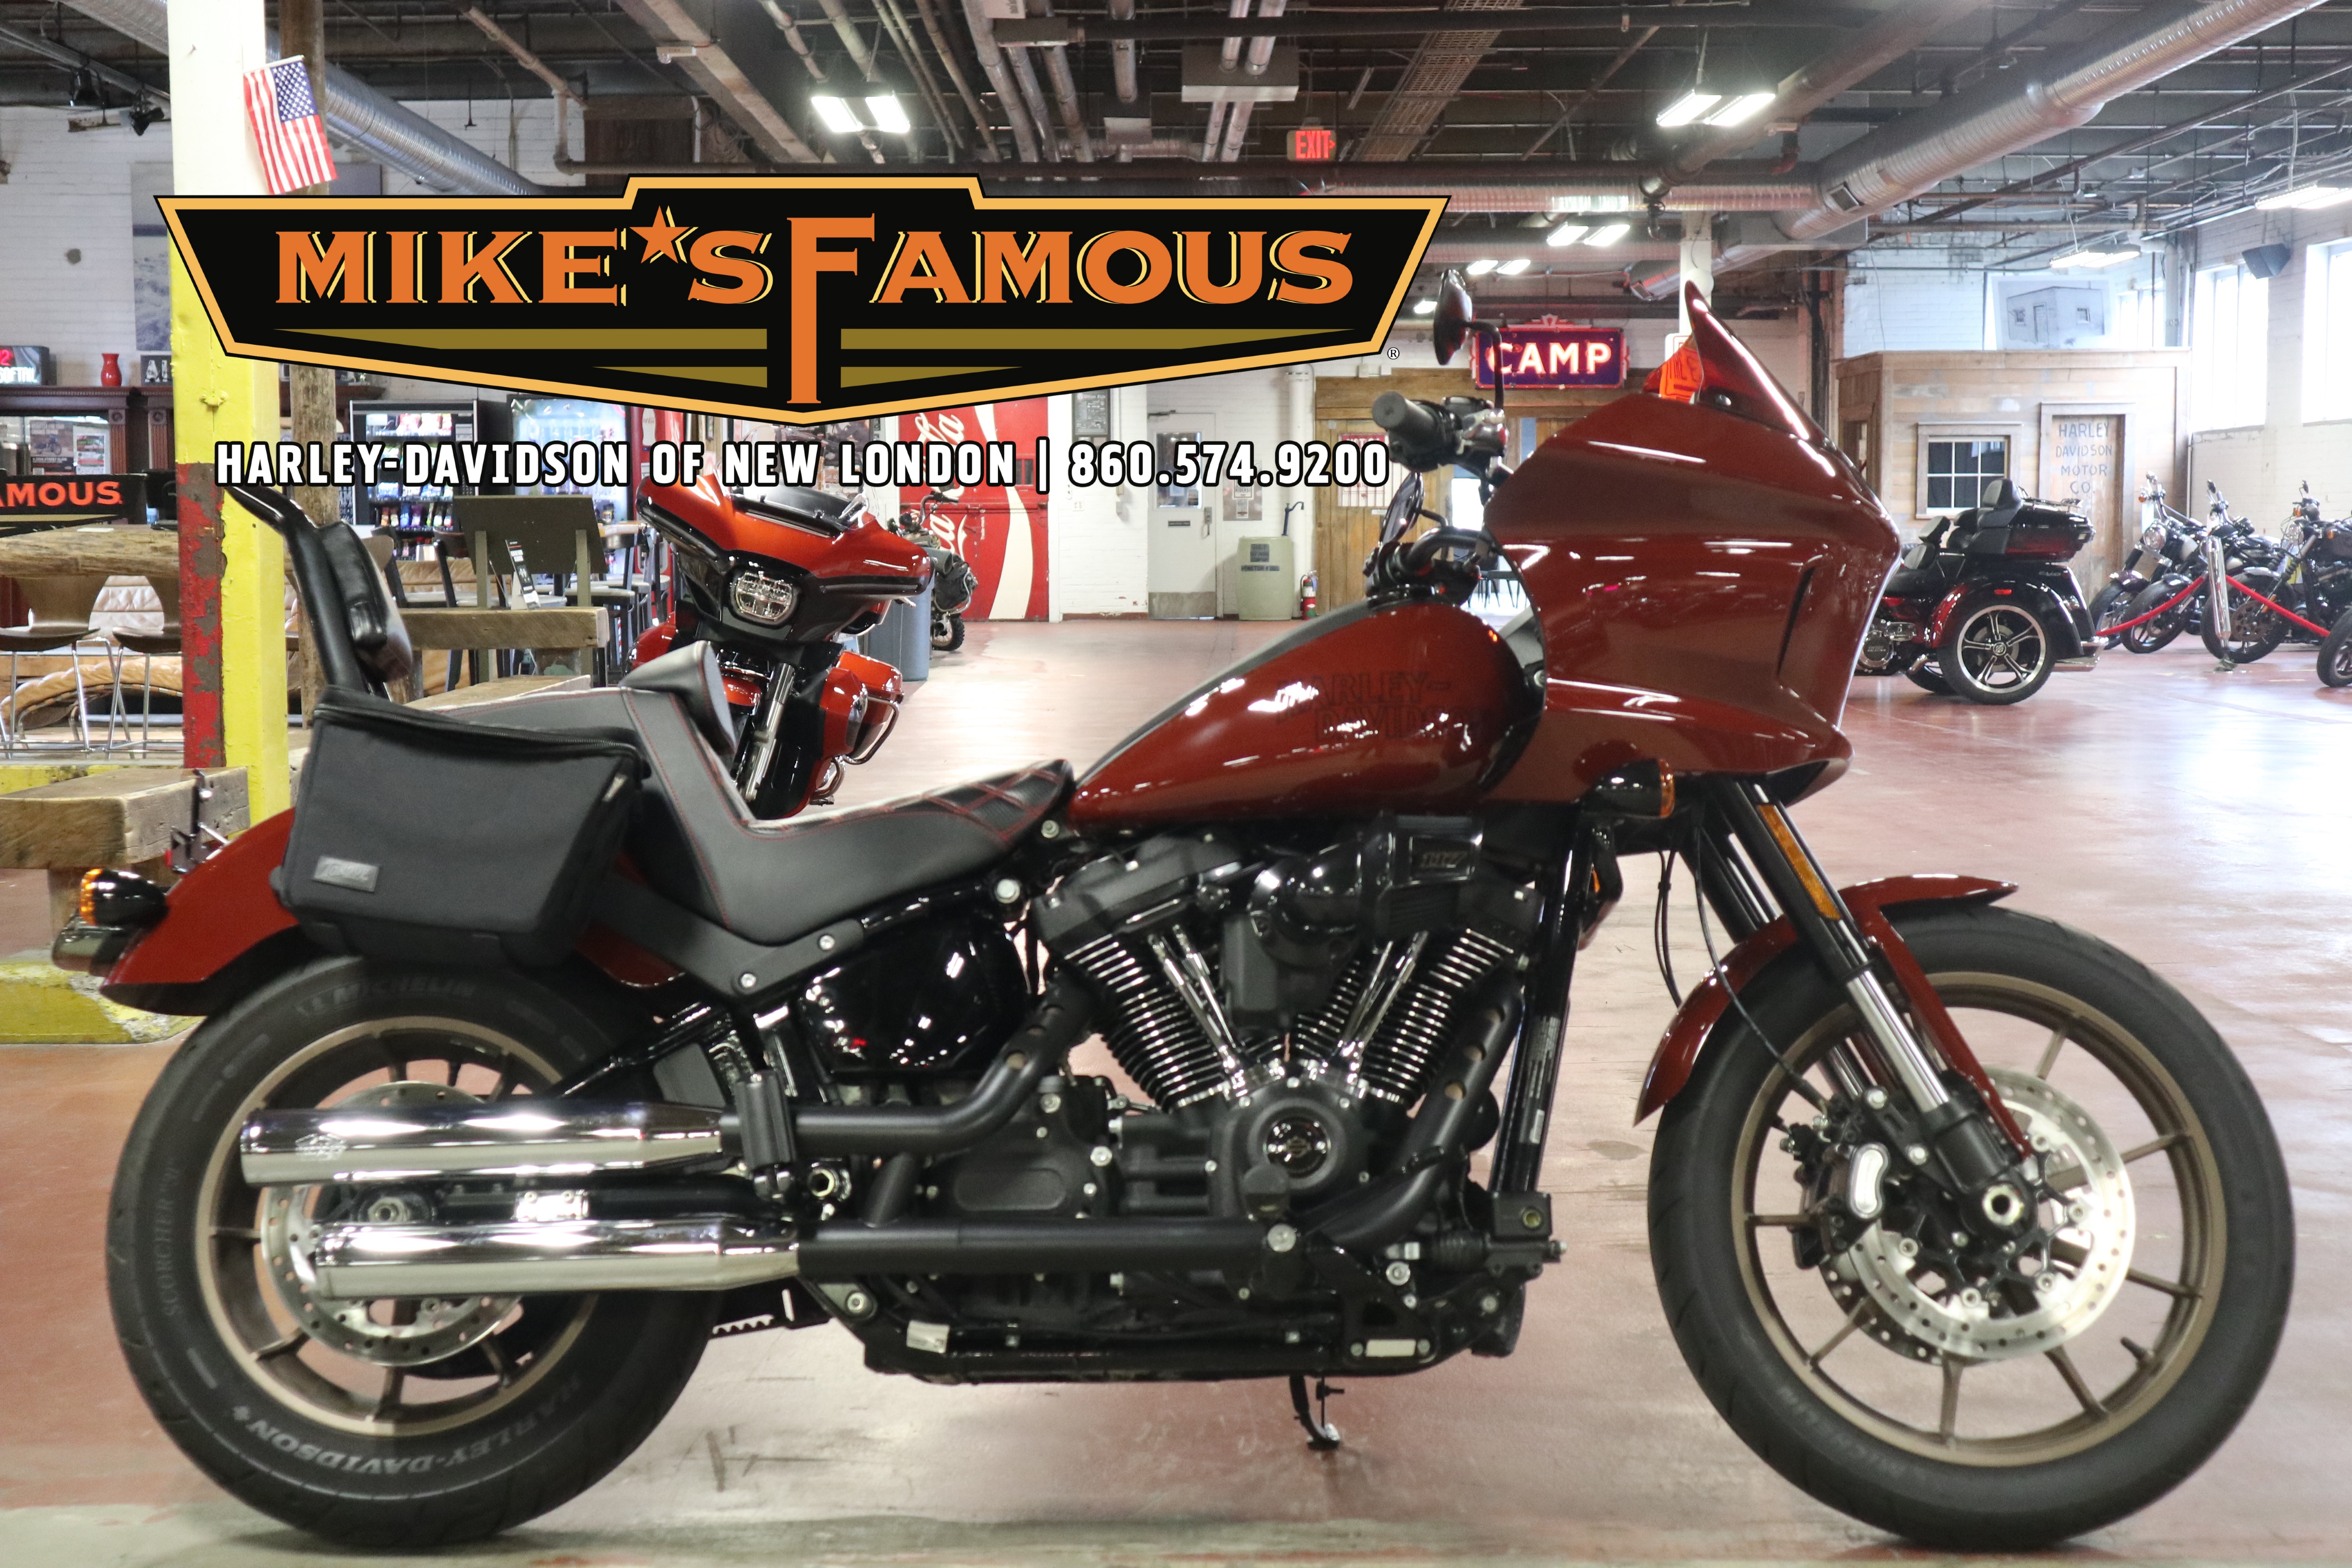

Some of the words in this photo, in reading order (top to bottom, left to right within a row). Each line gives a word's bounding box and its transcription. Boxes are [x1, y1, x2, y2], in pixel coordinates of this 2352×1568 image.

[1296, 131, 1331, 159] EXIT
[1485, 342, 1611, 374] CAMP
[2059, 422, 2109, 437] HARLEY
[2056, 445, 2112, 457] DAVIDSON
[2061, 465, 2107, 476] MOTOR
[2070, 481, 2095, 494] CO.
[153, 1197, 183, 1316] SCORCHER
[247, 1375, 581, 1475] HARLEY-DAVIDSON
